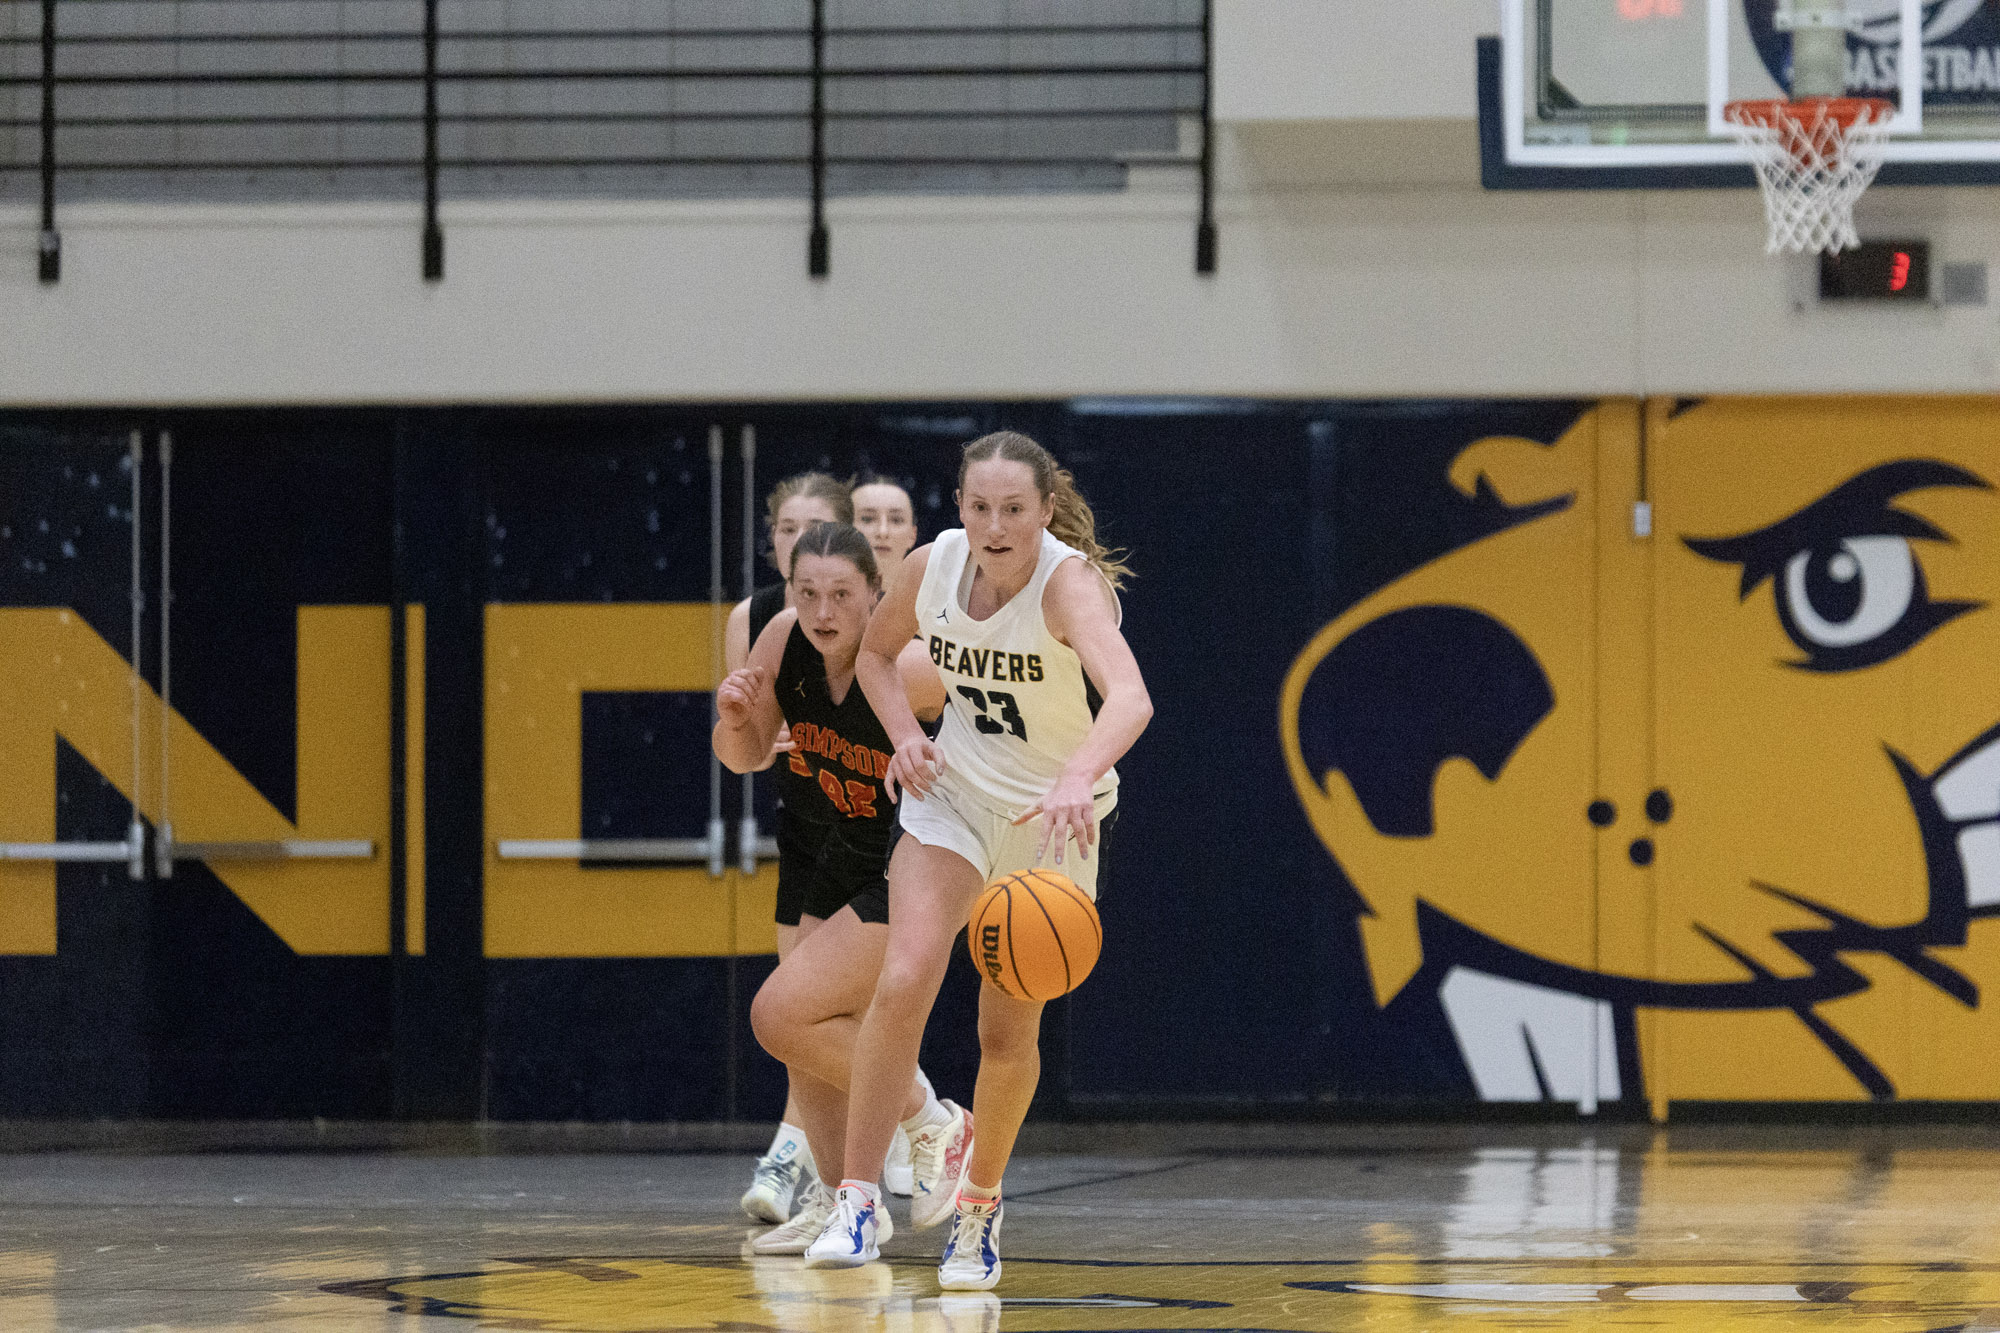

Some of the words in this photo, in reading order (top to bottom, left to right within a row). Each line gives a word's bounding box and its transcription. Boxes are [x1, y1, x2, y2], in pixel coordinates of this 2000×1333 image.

[1890, 251, 1911, 291] 3
[929, 634, 1044, 682] BEAVERS
[790, 722, 892, 780] SIMPSON
